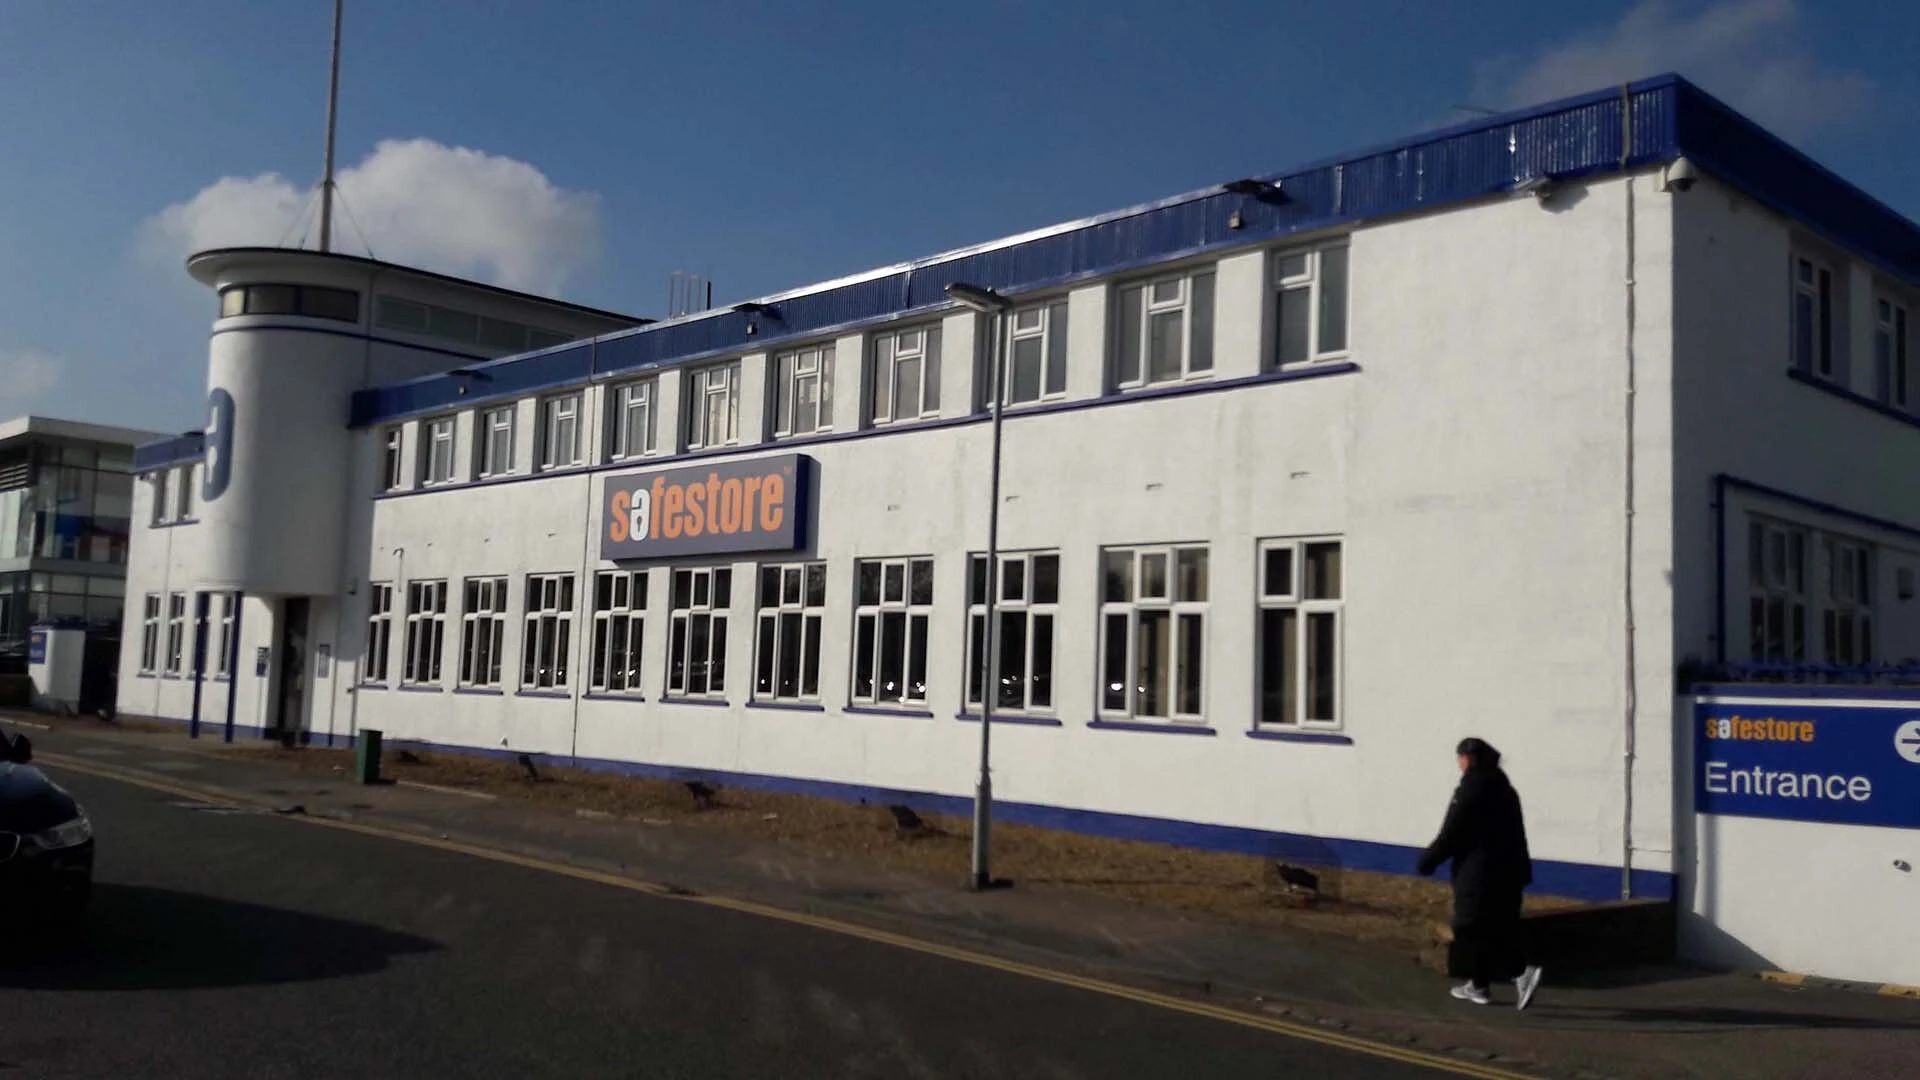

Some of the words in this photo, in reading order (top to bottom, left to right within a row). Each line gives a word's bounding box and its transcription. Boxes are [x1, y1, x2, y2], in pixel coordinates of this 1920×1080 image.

[610, 472, 784, 542] safestore
[1706, 716, 1814, 742] safestore
[1704, 761, 1873, 801] Entrance
